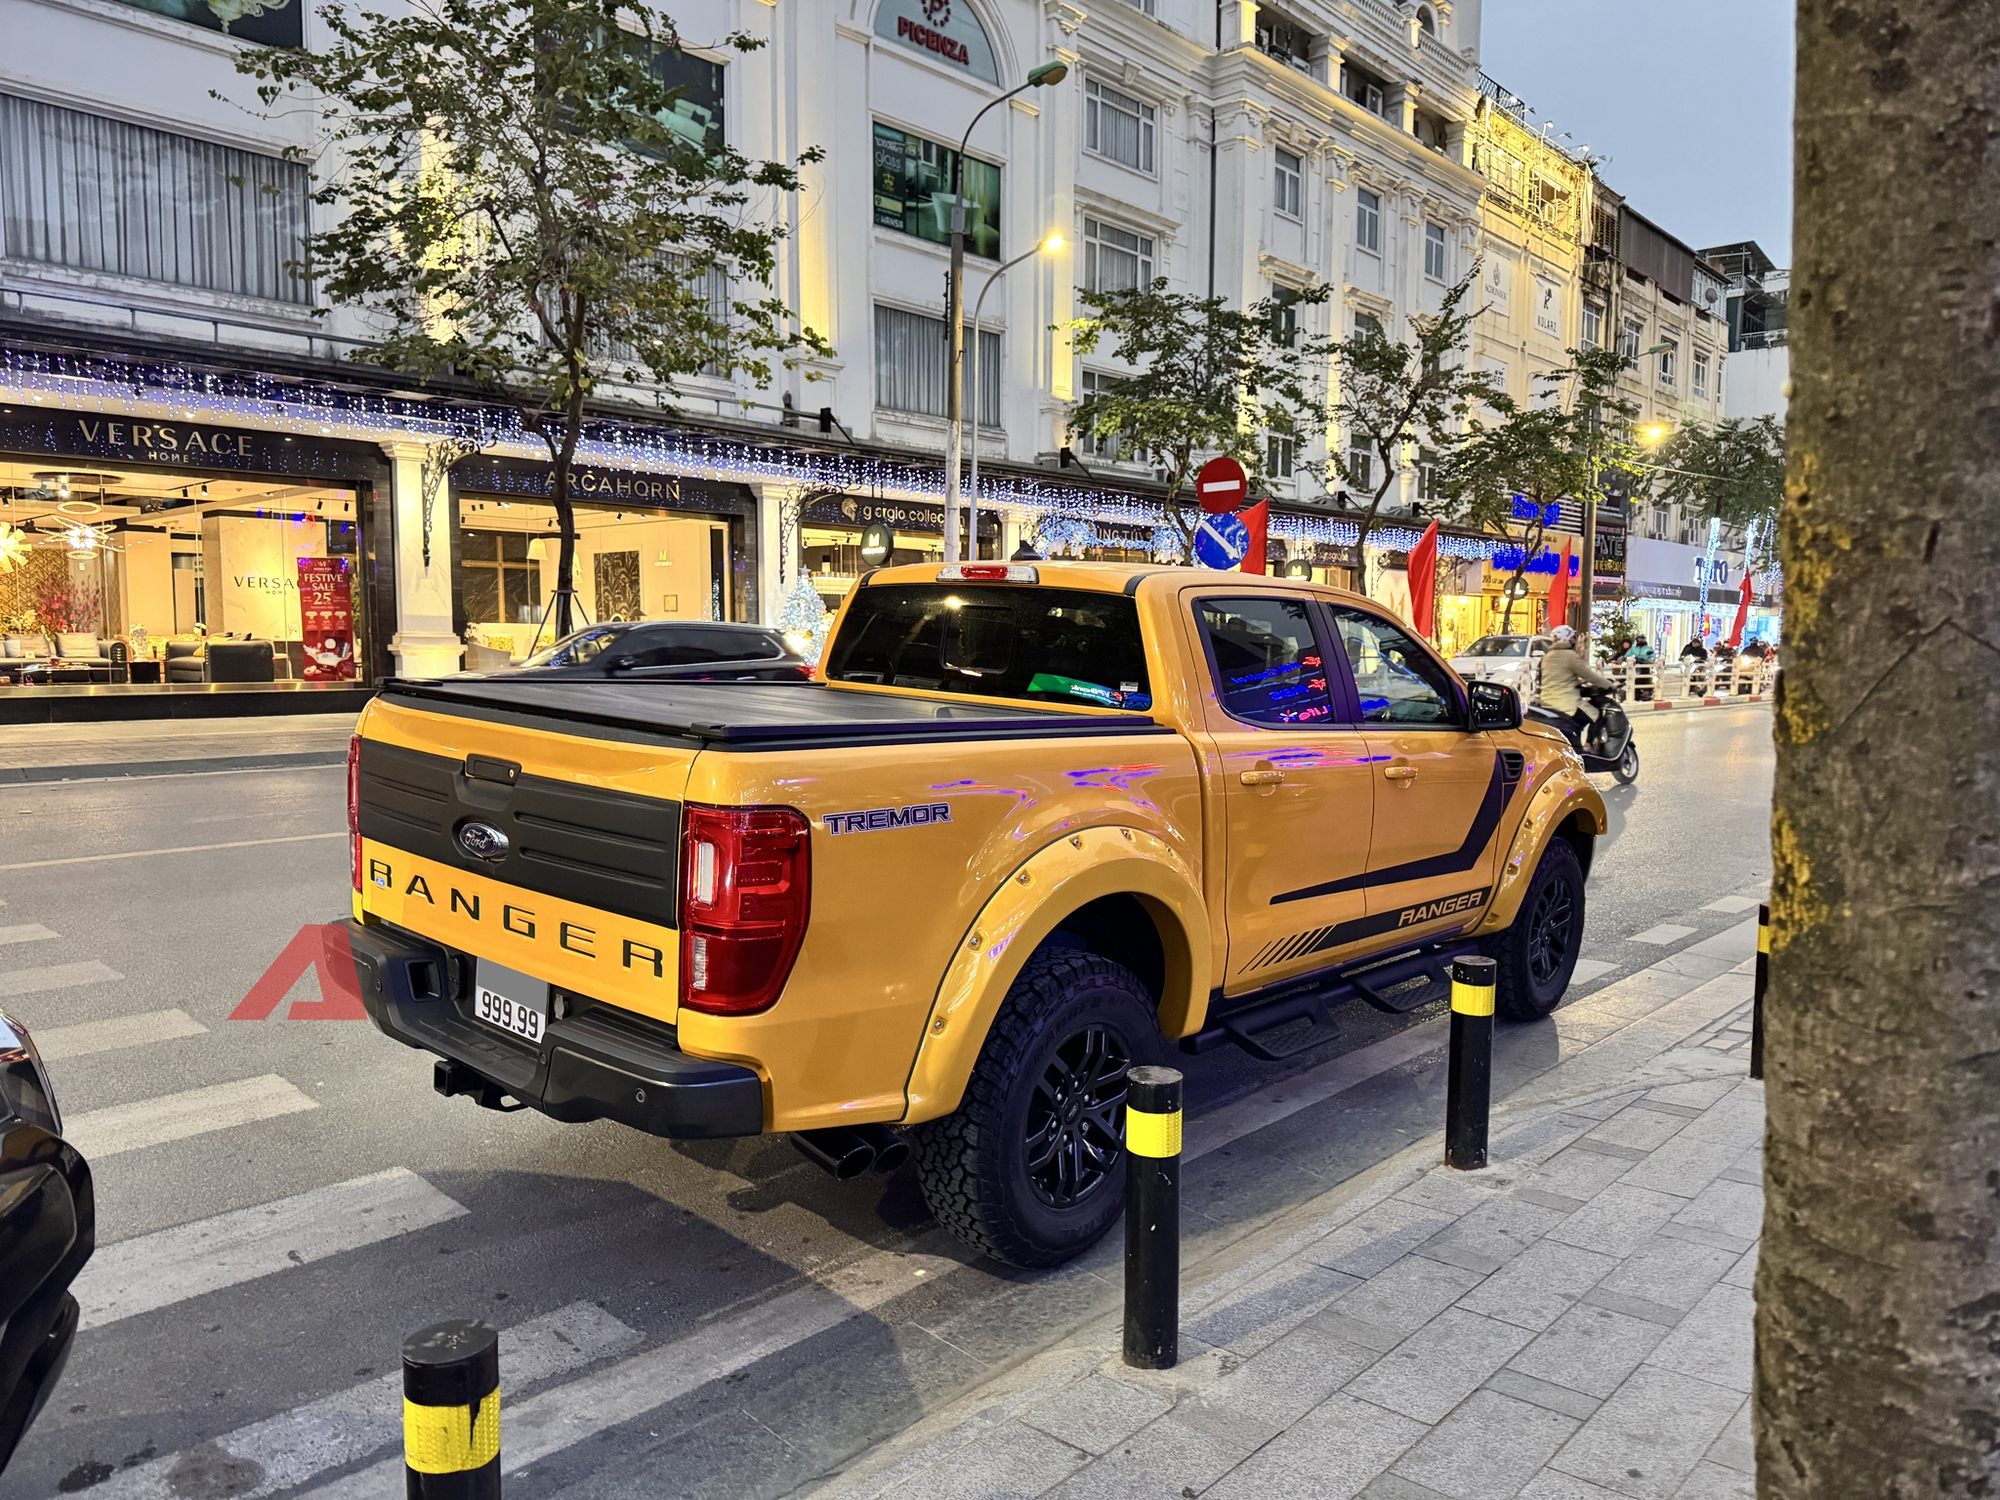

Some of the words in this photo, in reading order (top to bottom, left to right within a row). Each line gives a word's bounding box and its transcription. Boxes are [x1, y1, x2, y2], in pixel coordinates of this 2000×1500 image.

[897, 16, 970, 66] PICENZA
[875, 149, 902, 170] glass
[1537, 314, 1557, 333] KOLARZ
[78, 419, 253, 457] VERSACE
[148, 451, 189, 463] HOME
[544, 471, 681, 500] ARCAHORN
[304, 573, 344, 583] FESTIVE
[1694, 555, 1728, 585] TTO
[312, 583, 336, 592] SALE
[822, 801, 953, 836] TREMOR
[464, 828, 488, 850] Ford
[369, 858, 663, 978] RANGER
[1397, 891, 1483, 927] RANGER
[481, 990, 539, 1039] 999.99
